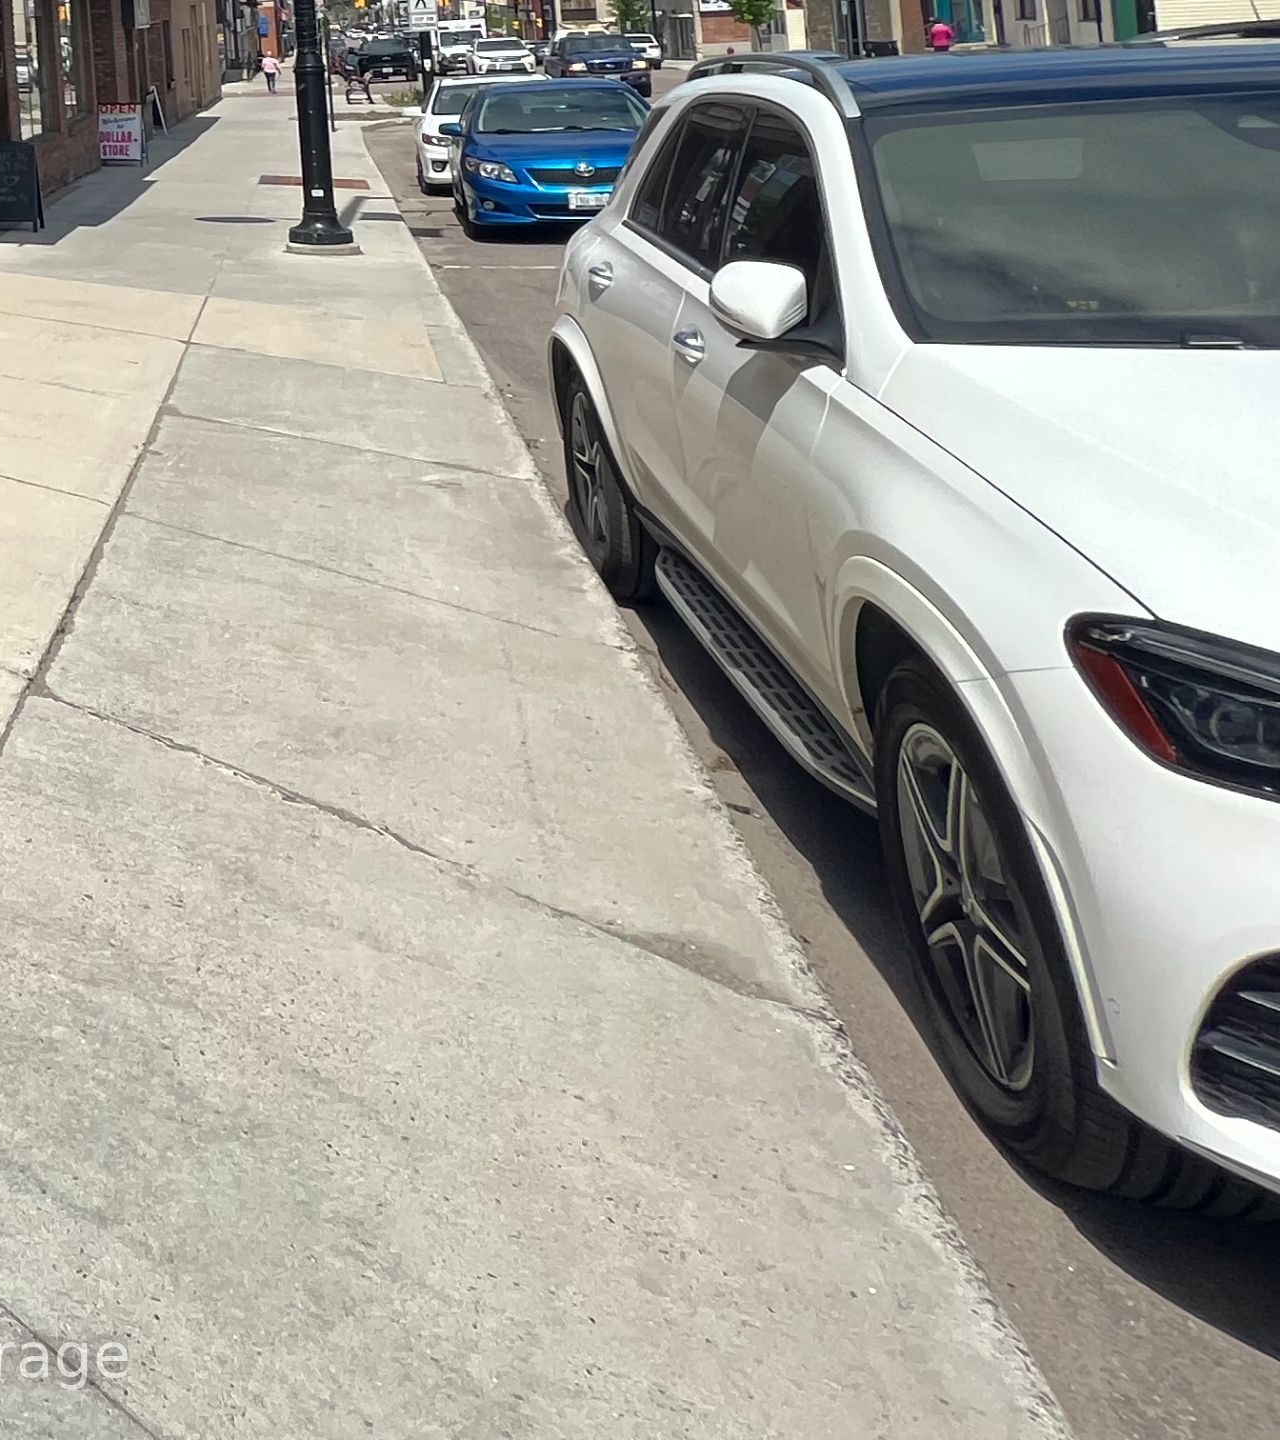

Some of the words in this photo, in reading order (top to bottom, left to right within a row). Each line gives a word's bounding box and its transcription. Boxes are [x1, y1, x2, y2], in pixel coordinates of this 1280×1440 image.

[100, 104, 137, 114] OPEN
[100, 131, 132, 143] DOLLAR
[102, 144, 130, 157] STORE
